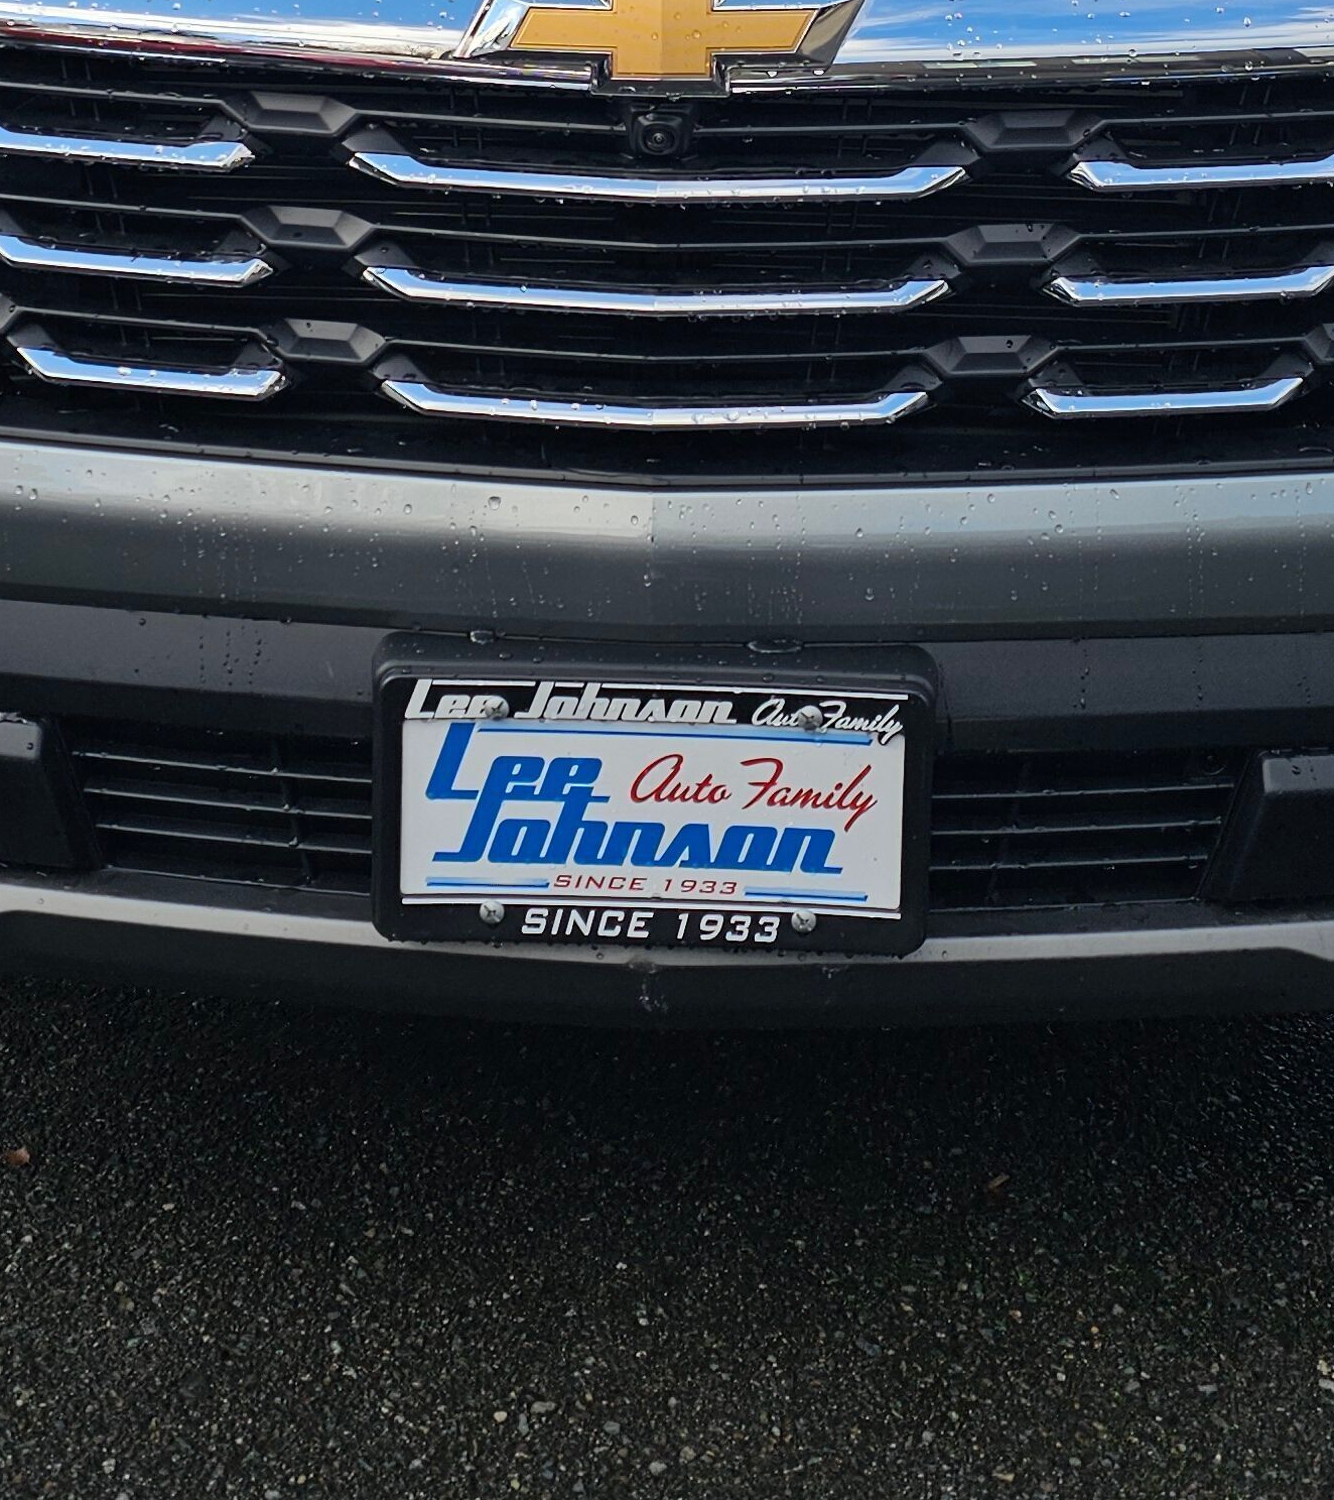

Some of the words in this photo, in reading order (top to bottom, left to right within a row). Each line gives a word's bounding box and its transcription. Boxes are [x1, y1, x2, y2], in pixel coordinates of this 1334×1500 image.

[514, 681, 736, 725] Johnson
[819, 700, 903, 745] Family
[425, 722, 610, 803] Lee
[630, 754, 732, 805] Auto
[740, 757, 878, 832] Family
[432, 799, 843, 875] Johnson
[553, 874, 646, 893] SINCE
[663, 878, 737, 896] 1933
[521, 907, 655, 938] SINCE
[675, 912, 780, 943] 1933
